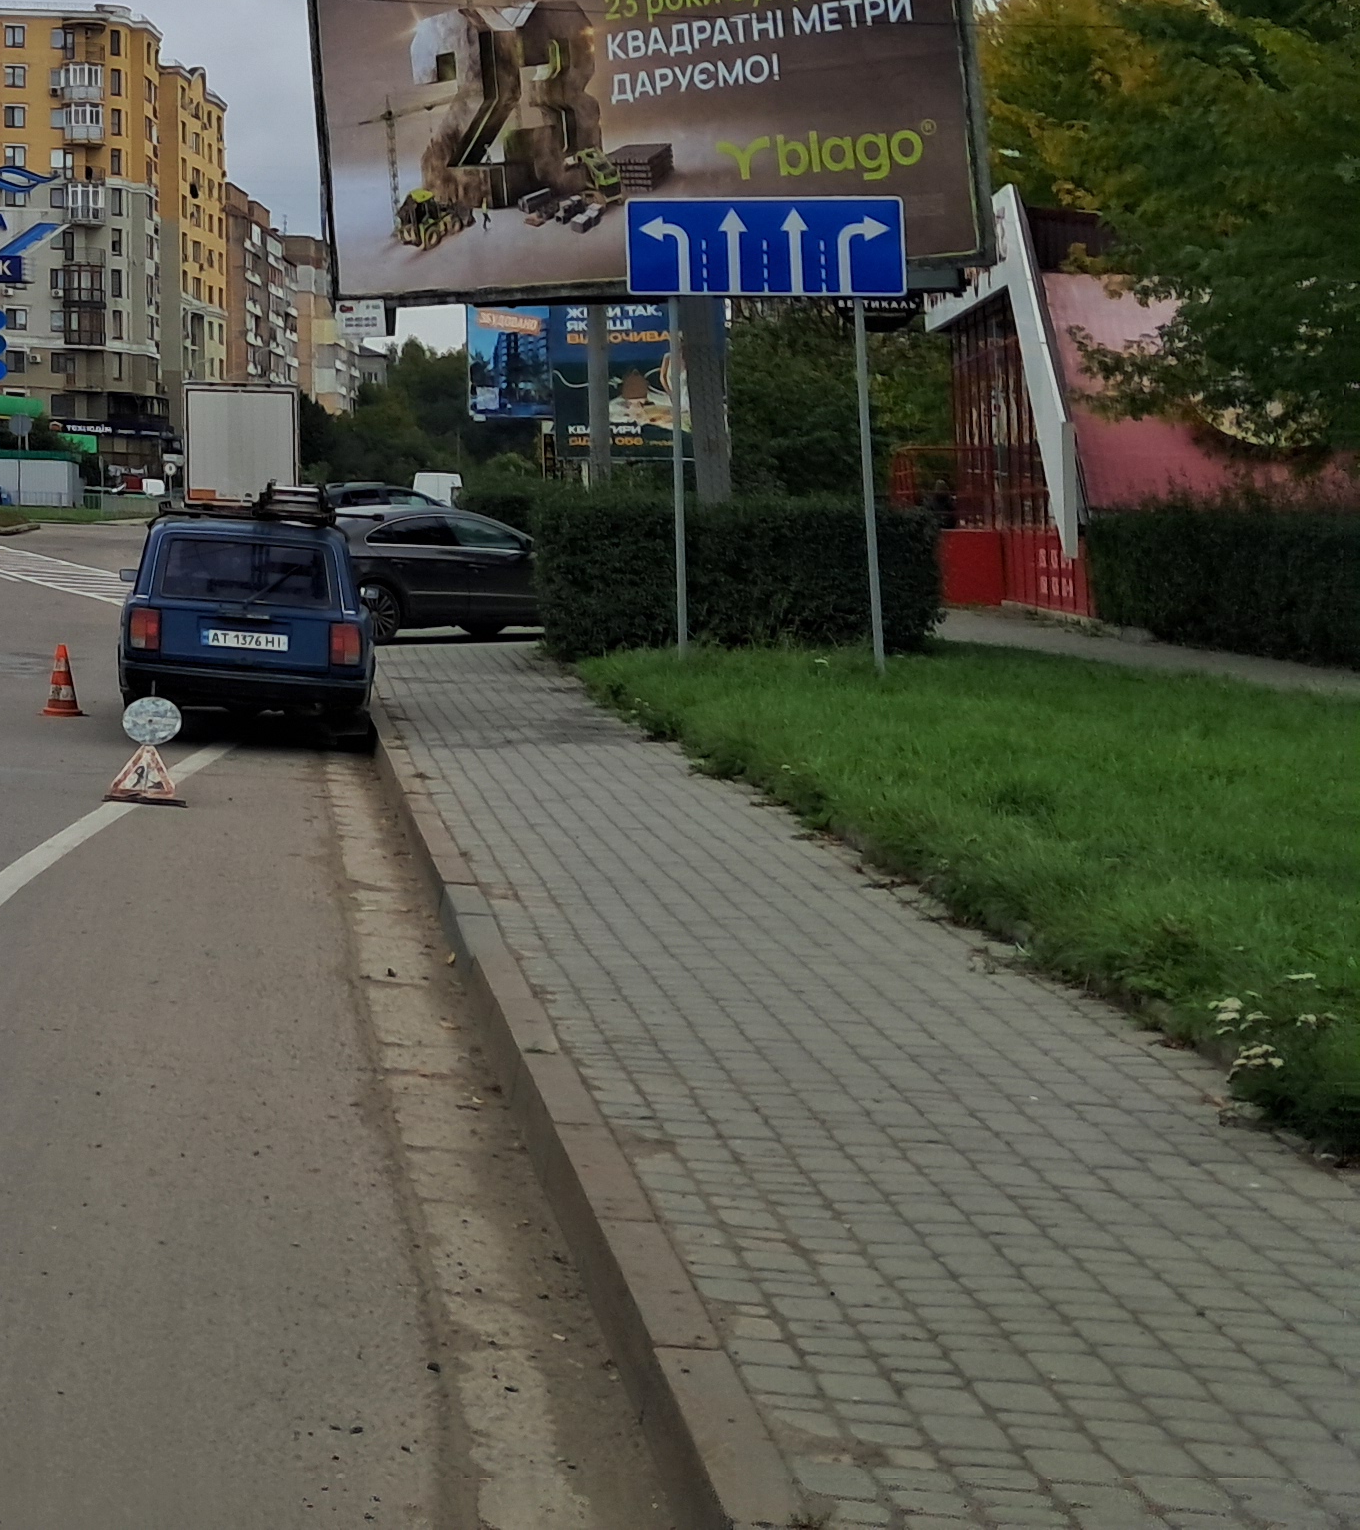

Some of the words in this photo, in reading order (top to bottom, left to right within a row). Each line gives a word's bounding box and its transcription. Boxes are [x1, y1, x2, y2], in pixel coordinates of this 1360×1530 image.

[606, 11, 785, 61] КВАДРАТНІ
[610, 52, 780, 105] ДАРУЄМО!
[626, 305, 663, 317] ТАК,
[838, 299, 917, 310] ВЕТИКАЛЬ
[479, 311, 538, 330] ЗБУДОВАНО
[566, 320, 588, 332] ЯК
[212, 632, 229, 644] AT
[233, 634, 262, 647] 1376
[265, 636, 281, 648] HI
